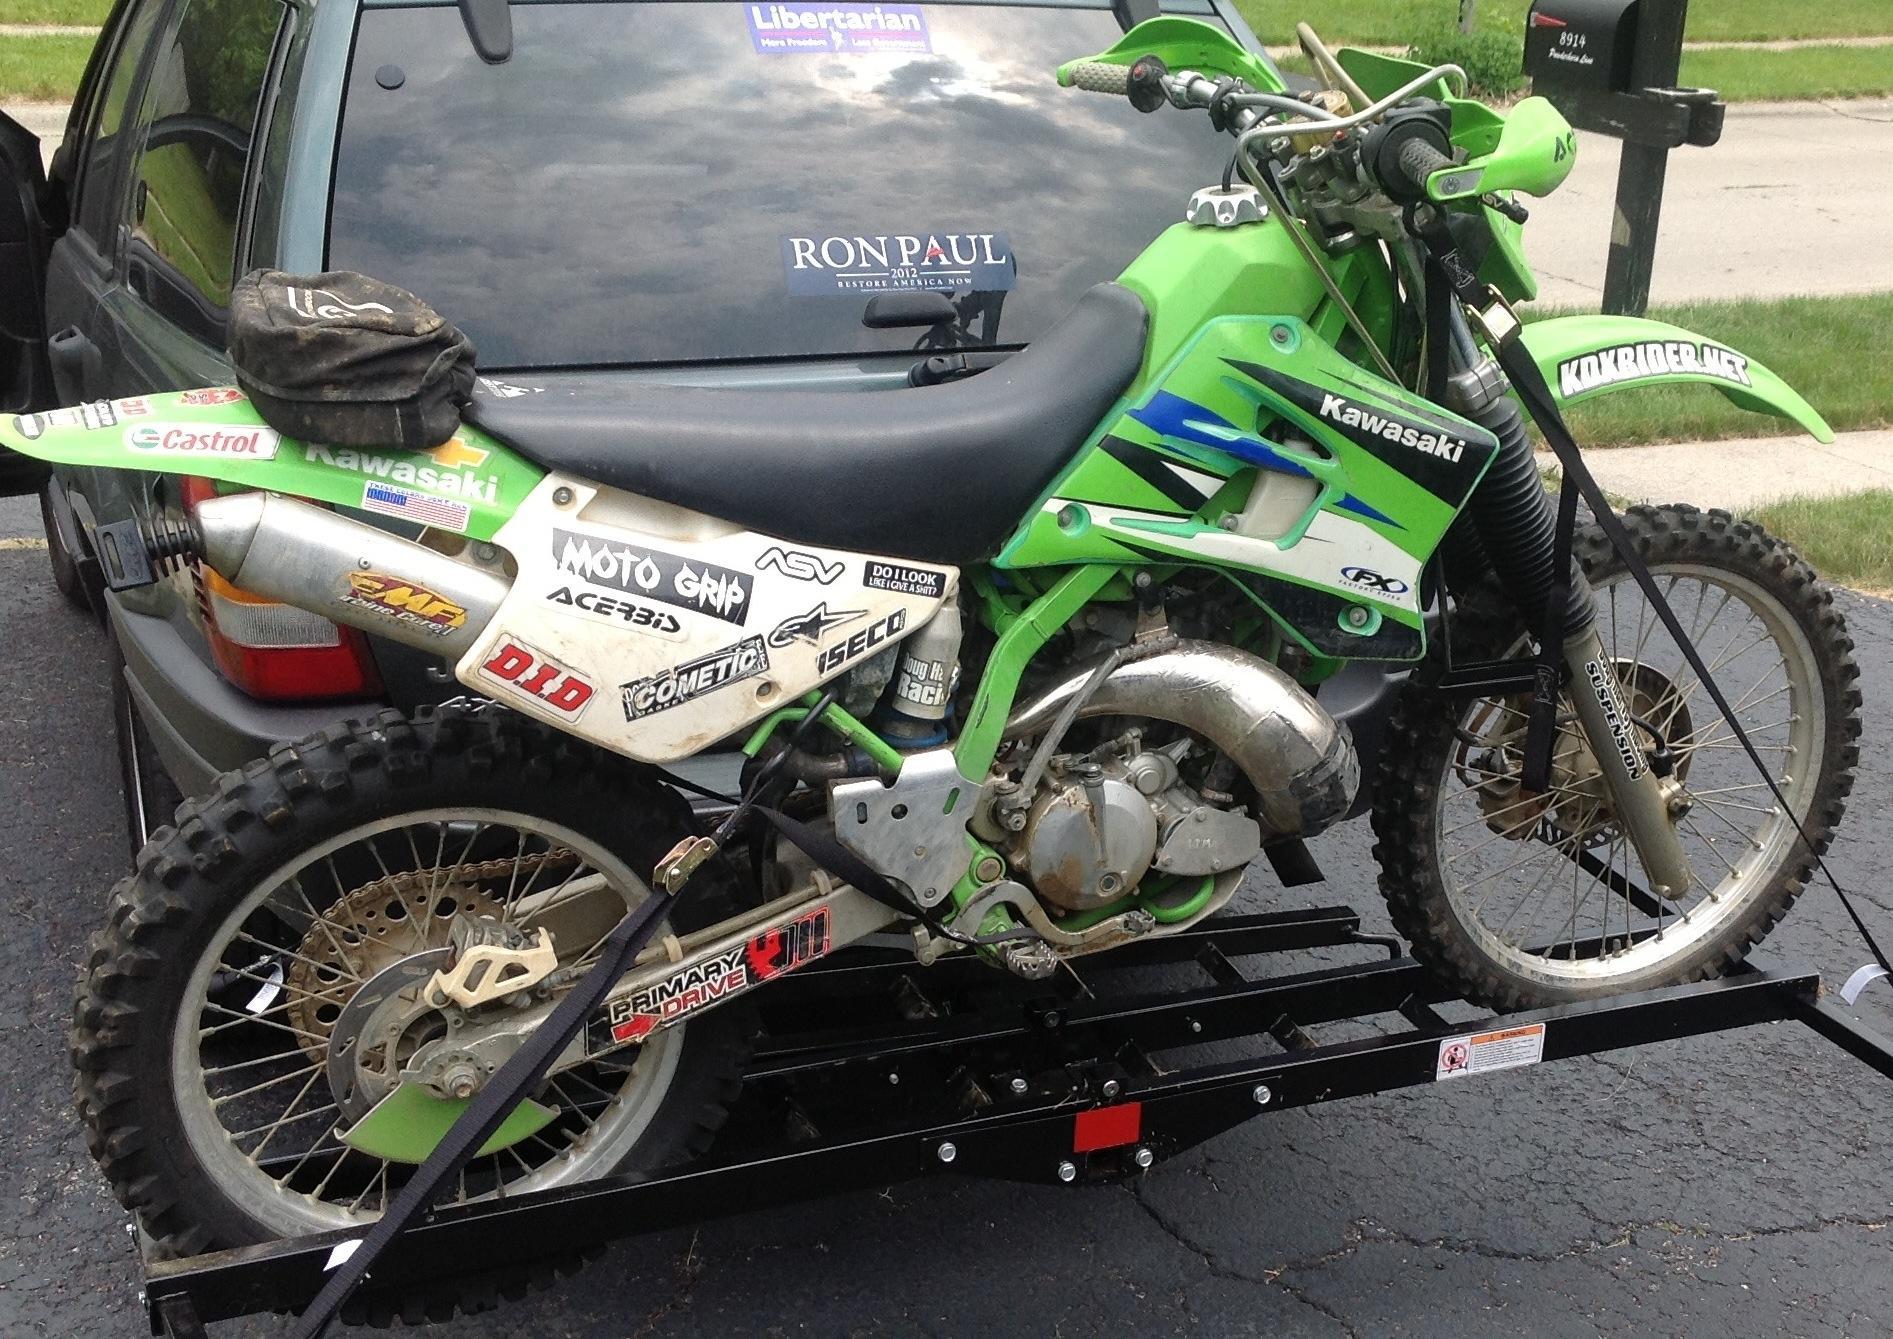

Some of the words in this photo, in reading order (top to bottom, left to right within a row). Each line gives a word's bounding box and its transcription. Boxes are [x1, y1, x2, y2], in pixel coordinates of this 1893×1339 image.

[751, 5, 921, 31] Libertarian
[1559, 31, 1586, 48] 8914
[789, 236, 888, 269] RON
[894, 234, 1006, 266] PAUL
[838, 280, 888, 288] RESTORE
[893, 278, 943, 287] AMERICA
[948, 277, 972, 285] NOW
[890, 268, 918, 279] 2012
[1558, 341, 1752, 398] KDXRIDER.NET
[163, 429, 259, 454] Castrol
[1319, 393, 1466, 463] Kawasaki
[305, 442, 498, 503] Kawasaki
[560, 536, 661, 590] MOTO
[674, 561, 745, 617] GRIP
[755, 547, 845, 586] ASV
[869, 577, 886, 588] LIKE
[890, 579, 908, 592] GIVE
[908, 582, 915, 592] A
[872, 564, 893, 579] DO
[894, 568, 899, 580] I
[901, 569, 937, 586] LOOK
[1351, 569, 1398, 592] FX
[350, 573, 465, 621] FMF
[482, 643, 593, 712] D.I.D
[636, 645, 760, 710] COMETIC
[1585, 661, 1642, 781] SUSPENSION
[610, 947, 747, 1024] PRIMARY
[661, 965, 748, 1021] DRIVE
